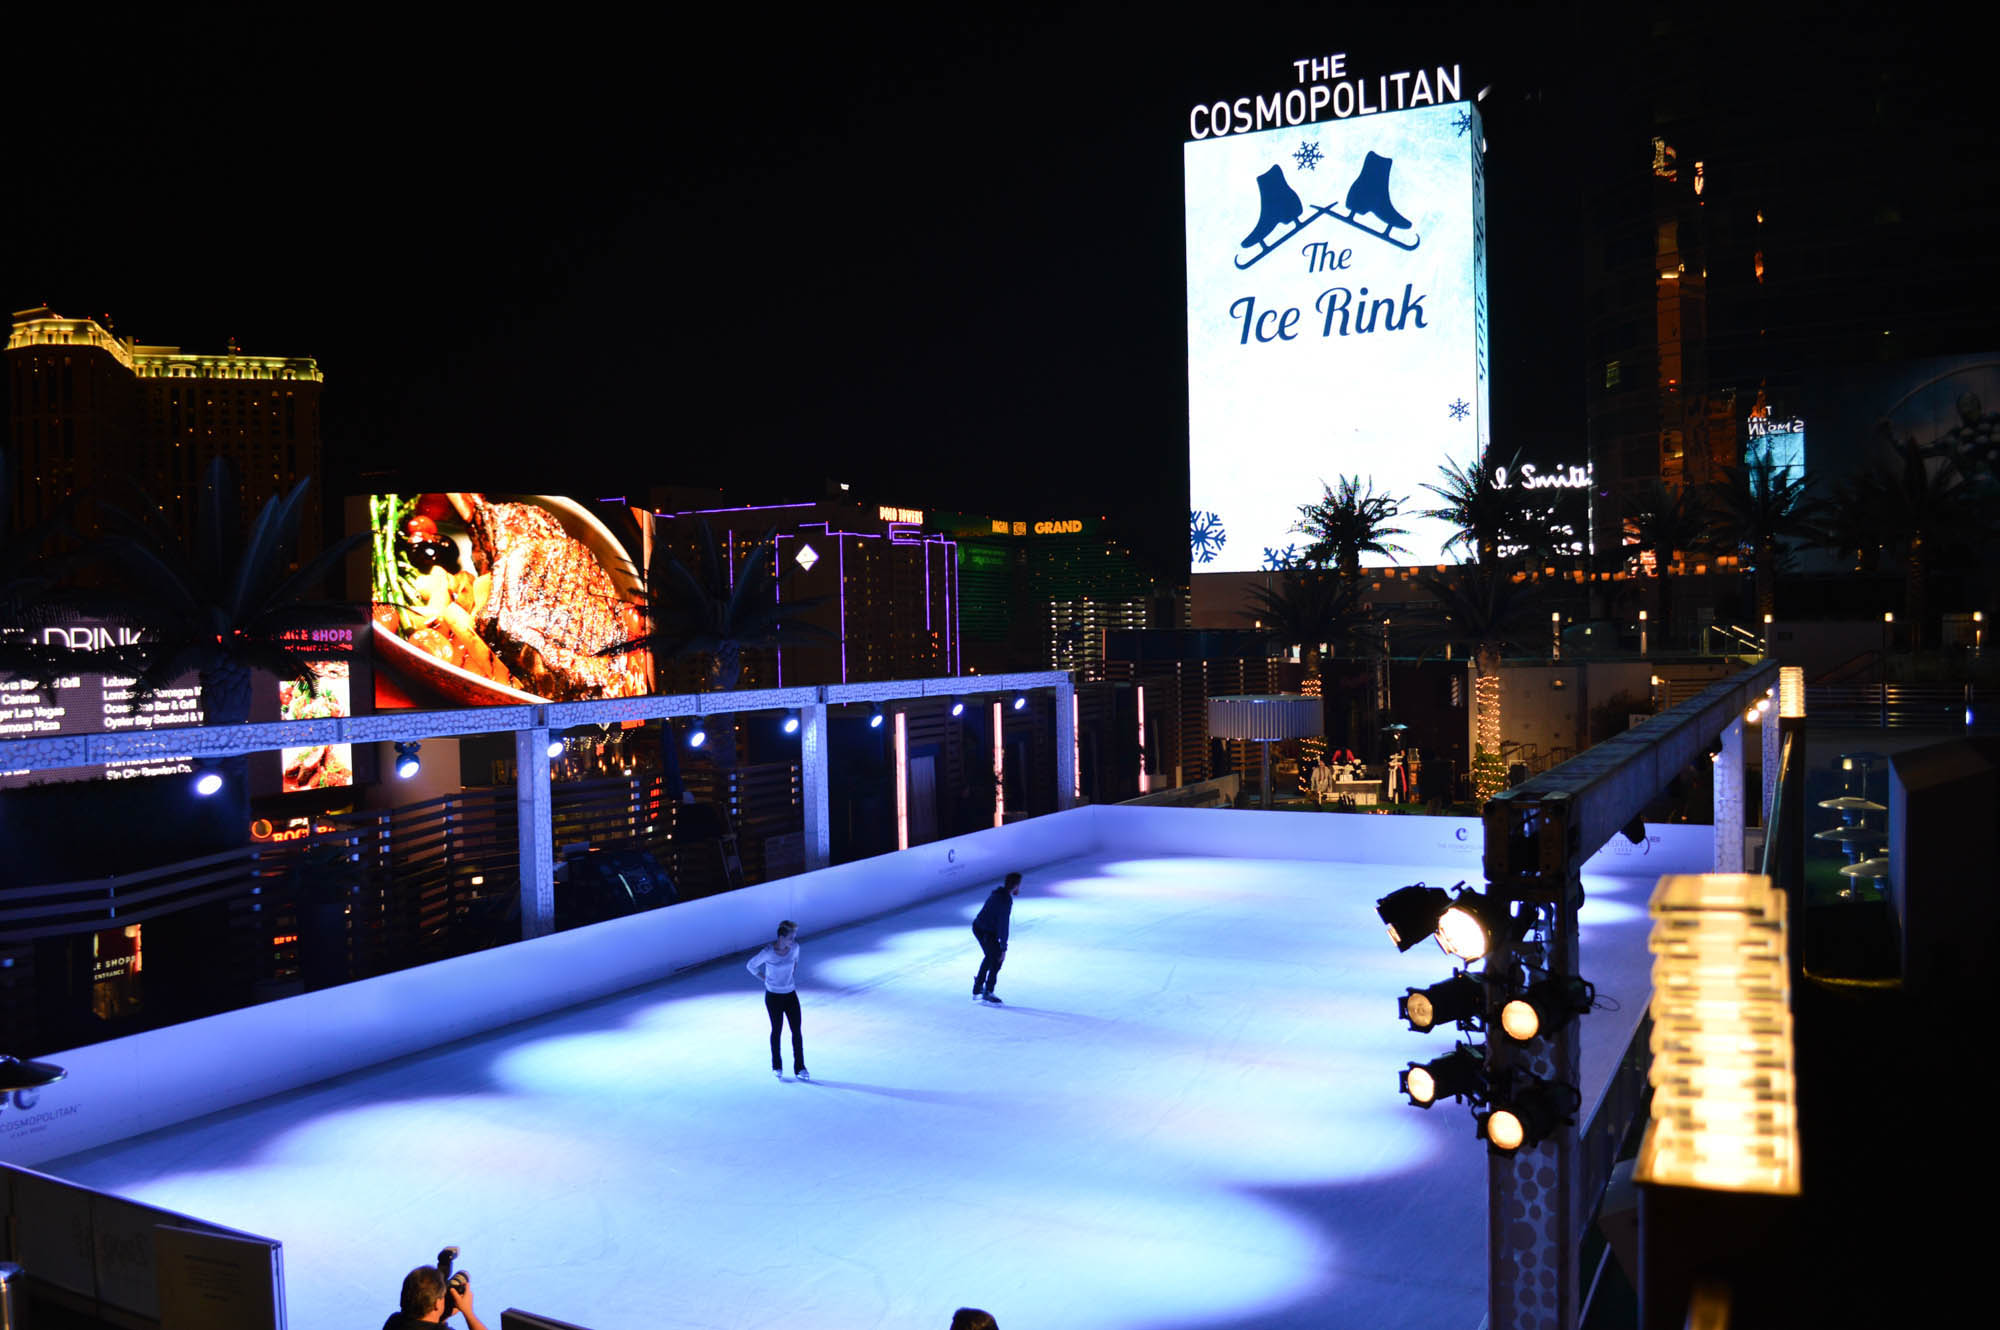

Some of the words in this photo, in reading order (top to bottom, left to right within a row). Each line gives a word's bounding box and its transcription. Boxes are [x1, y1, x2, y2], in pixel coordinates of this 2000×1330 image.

[1293, 53, 1346, 83] THE
[1189, 64, 1461, 140] COSMOPOLITAN
[1301, 241, 1353, 273] The
[1229, 295, 1301, 345] Ice
[1315, 283, 1428, 338] Rink
[1034, 520, 1082, 535] GRAND
[312, 628, 352, 642] SHOPS
[61, 677, 80, 689] Grill
[15, 708, 34, 718] Las
[34, 706, 65, 719] Vegas
[155, 701, 170, 711] Bar
[171, 701, 179, 710] &
[180, 699, 197, 709] Grill
[34, 721, 60, 731] Pizza
[104, 717, 134, 729] Oyster
[135, 715, 153, 727] Bay
[154, 712, 189, 724] Seafood
[190, 712, 197, 722] &
